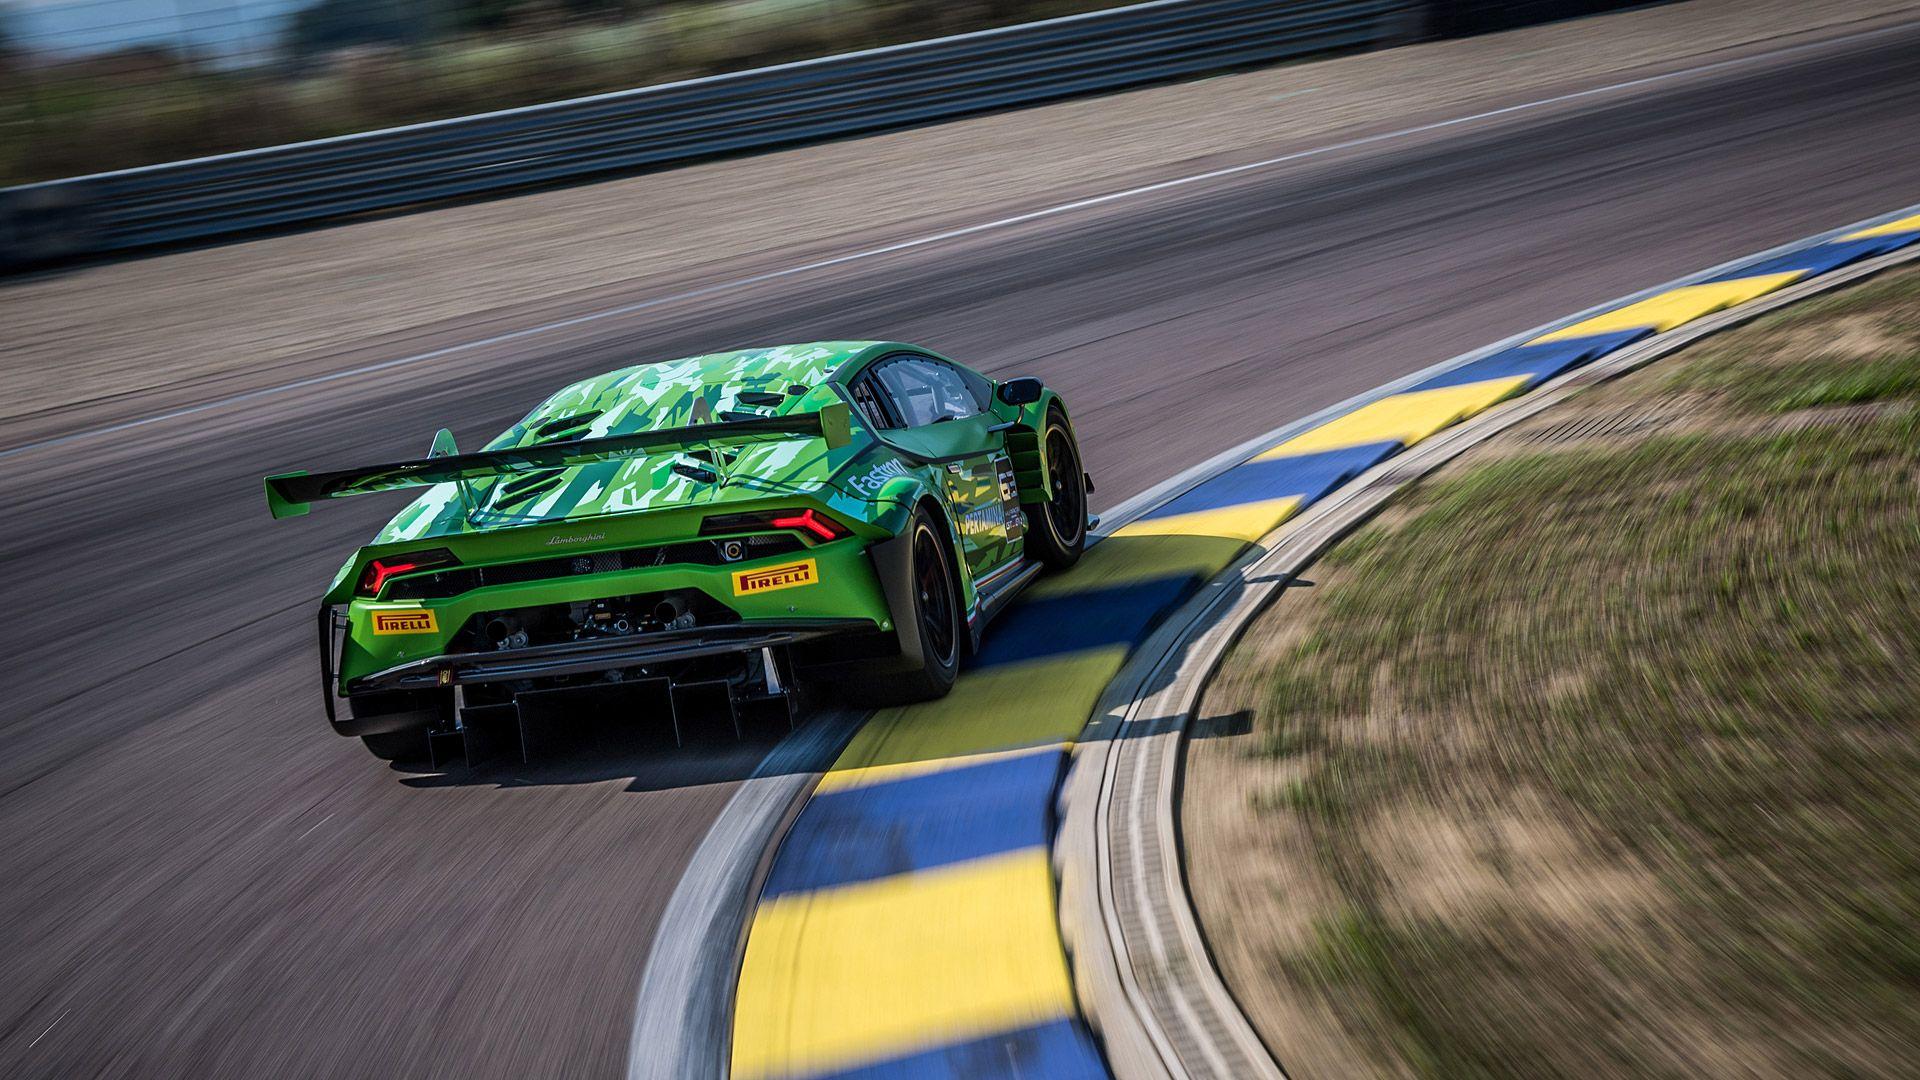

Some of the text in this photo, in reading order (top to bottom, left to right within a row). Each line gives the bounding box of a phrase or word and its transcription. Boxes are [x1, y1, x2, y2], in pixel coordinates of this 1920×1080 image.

[848, 458, 909, 496] Fastron
[965, 501, 1006, 535] PERTAMINA
[545, 532, 606, 545] Lamborghini
[740, 564, 809, 591] PIRELLI
[377, 613, 431, 631] PIRELLI
